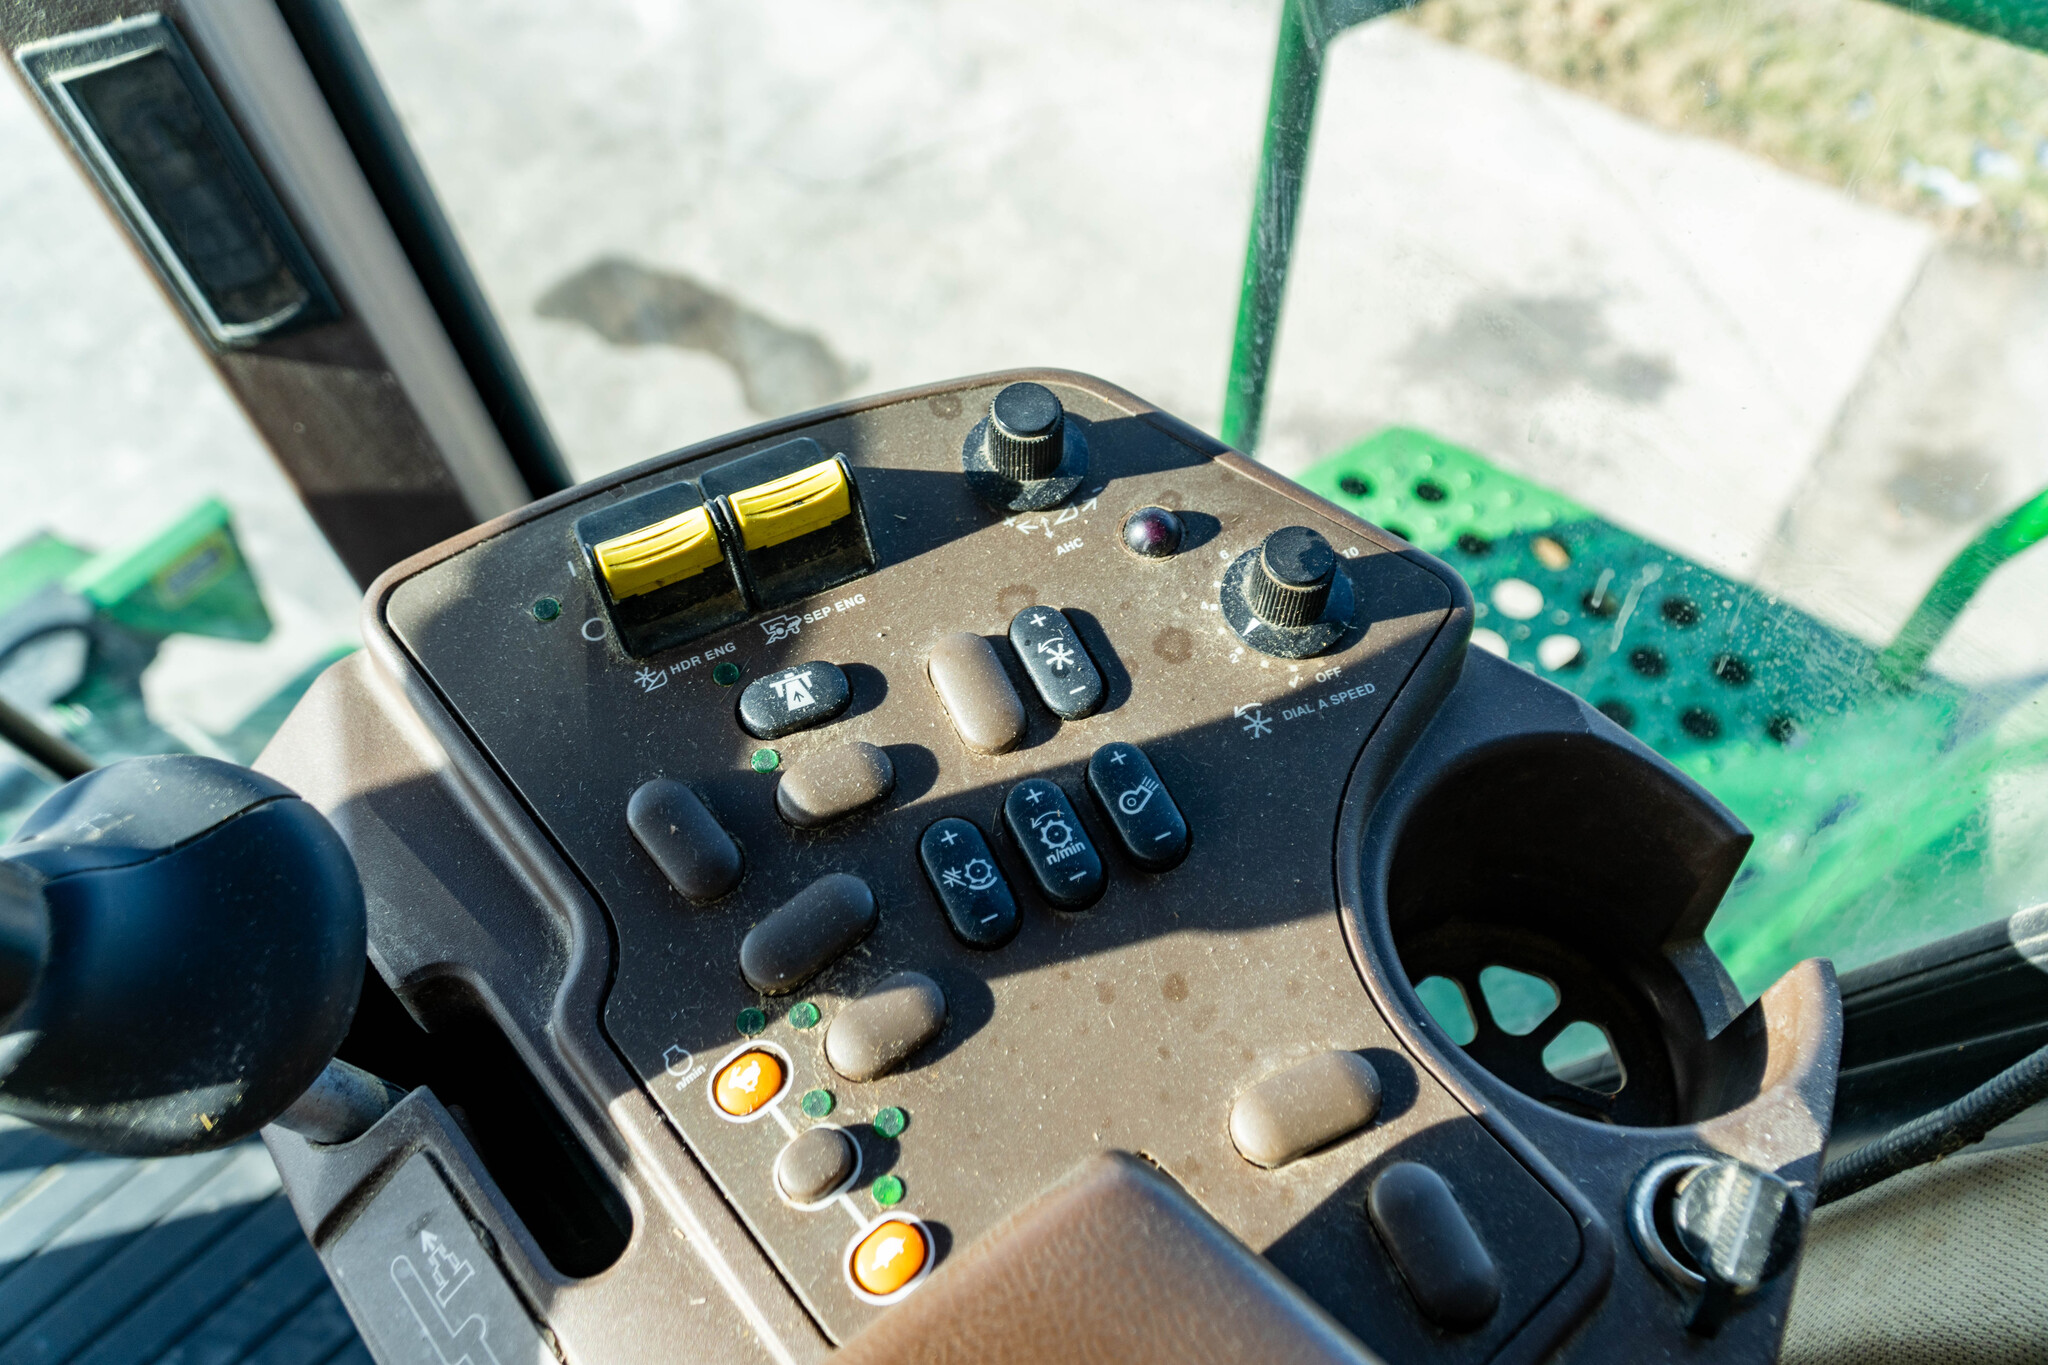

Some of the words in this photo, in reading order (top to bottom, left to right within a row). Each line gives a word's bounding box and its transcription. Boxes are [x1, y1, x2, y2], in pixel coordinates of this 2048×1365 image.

[1056, 538, 1085, 556] AHC
[1219, 549, 1230, 560] 6
[1341, 546, 1360, 559] 10
[803, 607, 832, 625] SEP
[834, 593, 866, 614] ENG
[669, 656, 702, 676] HDR
[704, 642, 737, 663] ENG
[1229, 653, 1240, 664] 2
[1315, 666, 1342, 683] OFF
[1282, 703, 1315, 721] DIAL
[1318, 699, 1329, 711] A
[1330, 683, 1376, 706] SPEED
[1046, 841, 1087, 866] n/min
